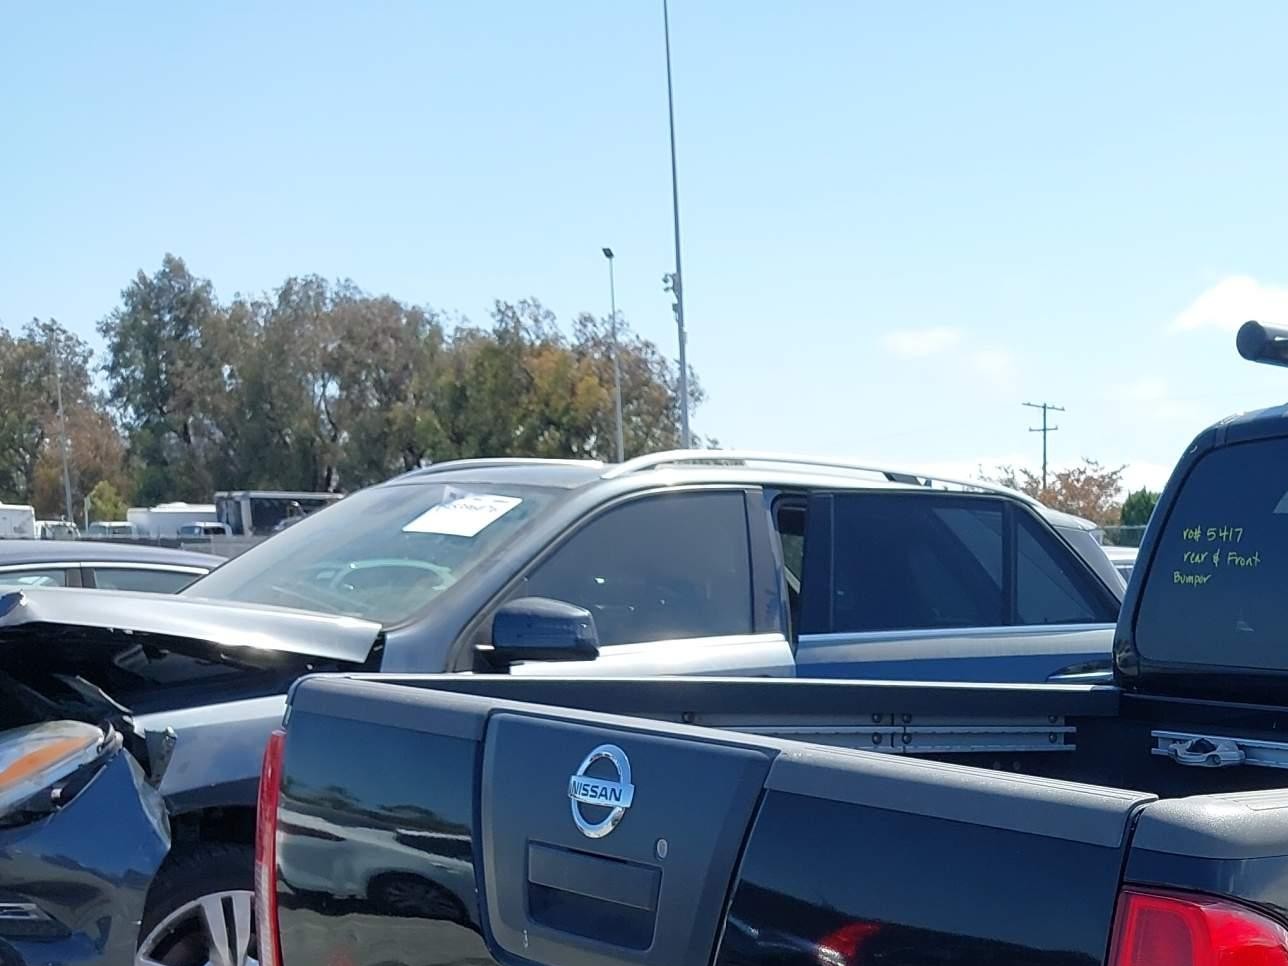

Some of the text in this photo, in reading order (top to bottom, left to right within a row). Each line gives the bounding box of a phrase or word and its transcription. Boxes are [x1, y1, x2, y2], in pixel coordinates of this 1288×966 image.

[1206, 526, 1244, 543] 5417
[1183, 551, 1208, 564] rear
[1227, 551, 1261, 567] Front
[571, 780, 623, 802] NISSAN
